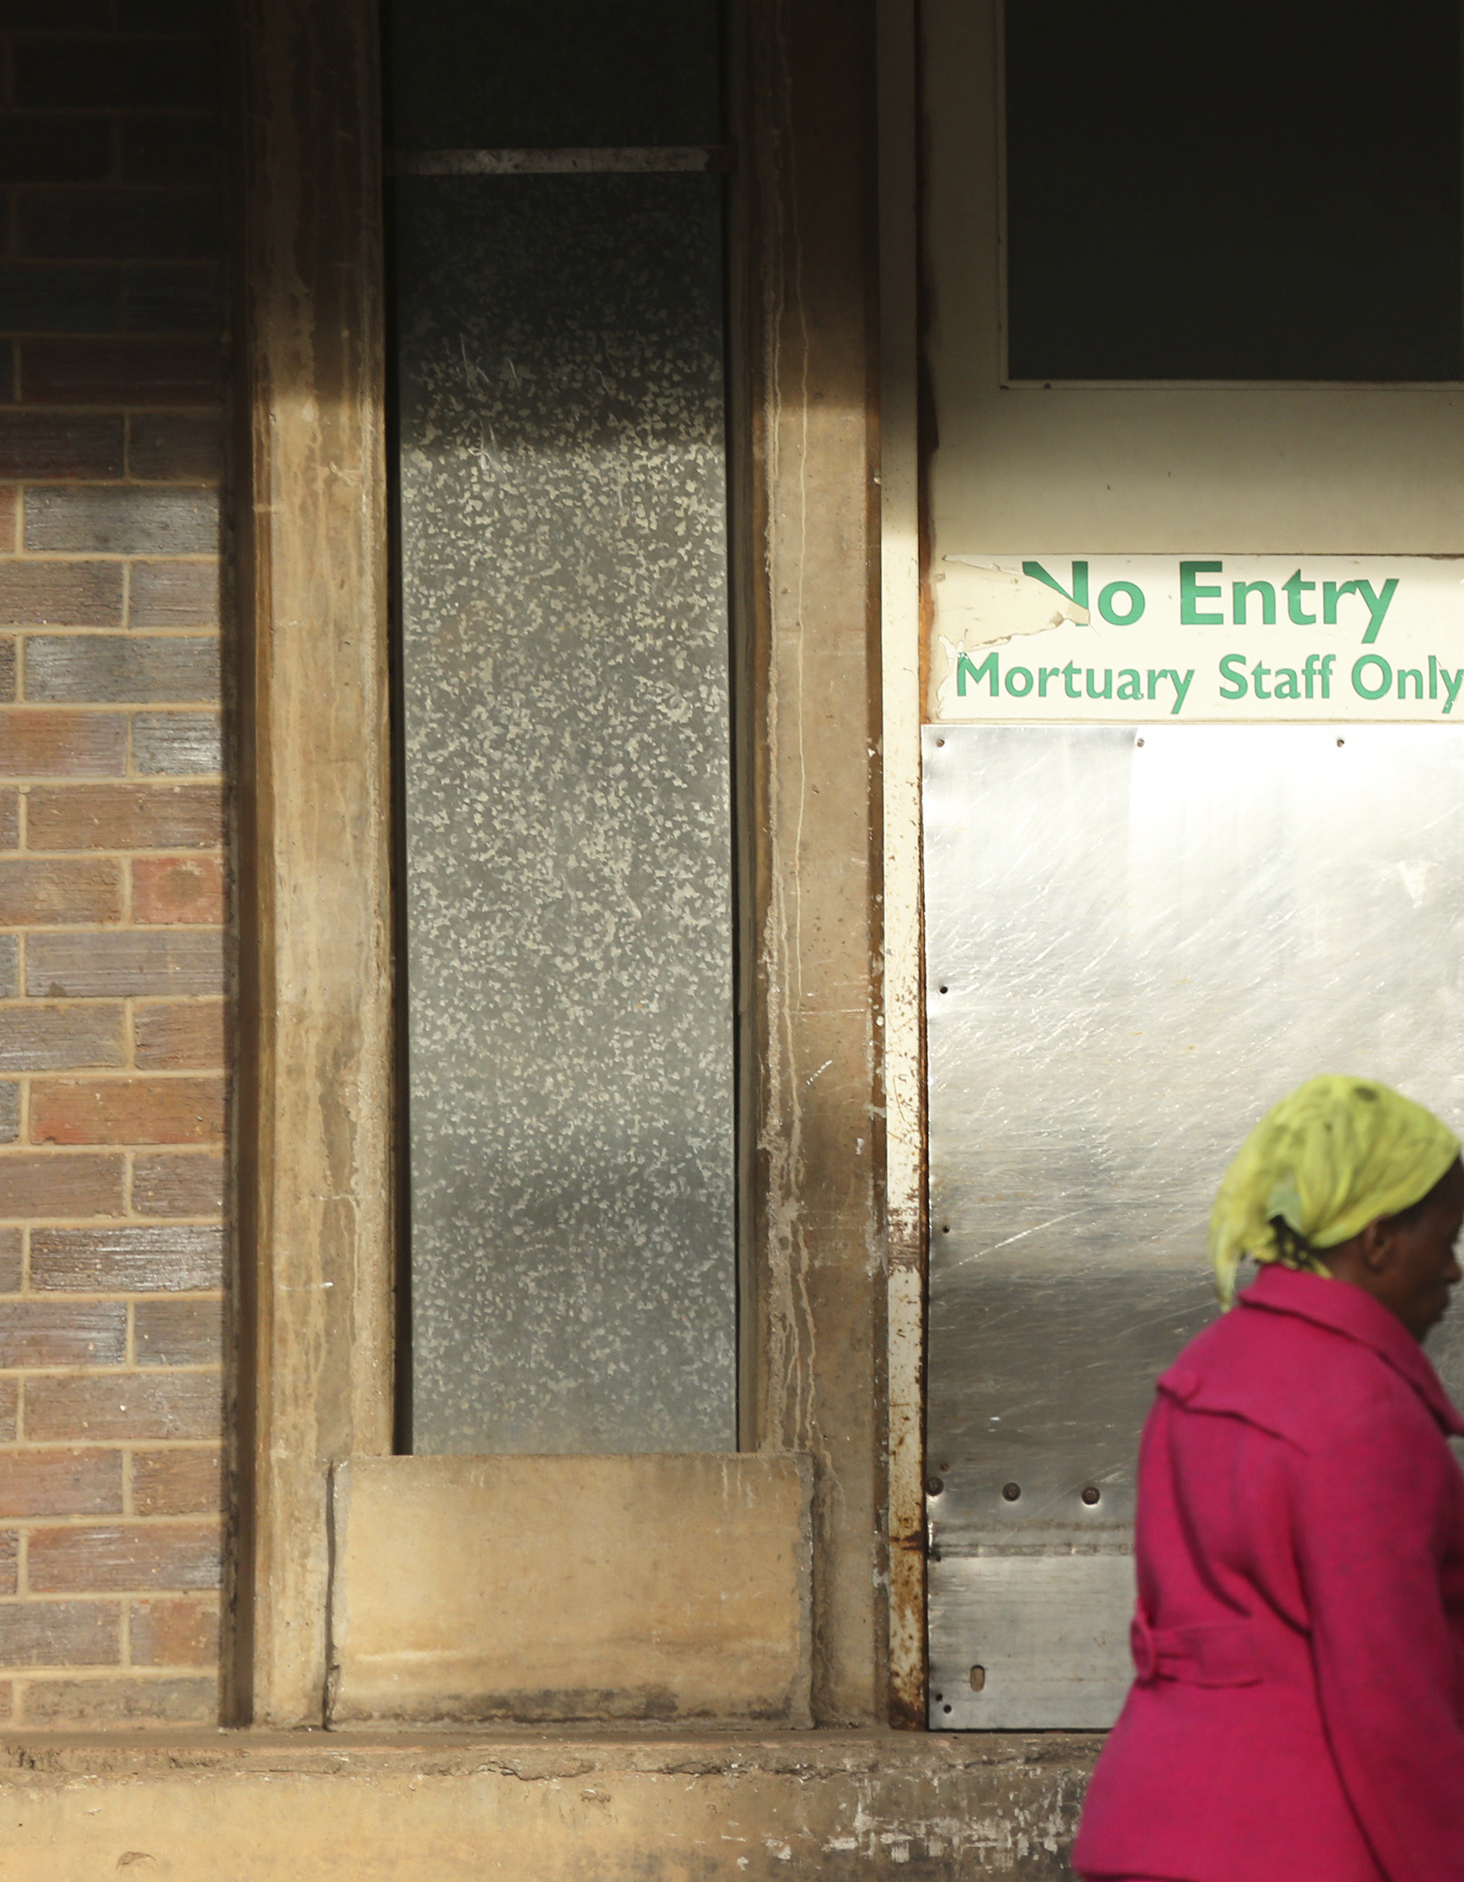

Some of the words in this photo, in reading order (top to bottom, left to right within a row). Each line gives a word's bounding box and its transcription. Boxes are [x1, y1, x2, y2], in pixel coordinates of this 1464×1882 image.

[1021, 560, 1147, 627] No
[1179, 560, 1400, 645] Entry
[956, 652, 1196, 714] Mortuary
[1217, 653, 1337, 701] Staff
